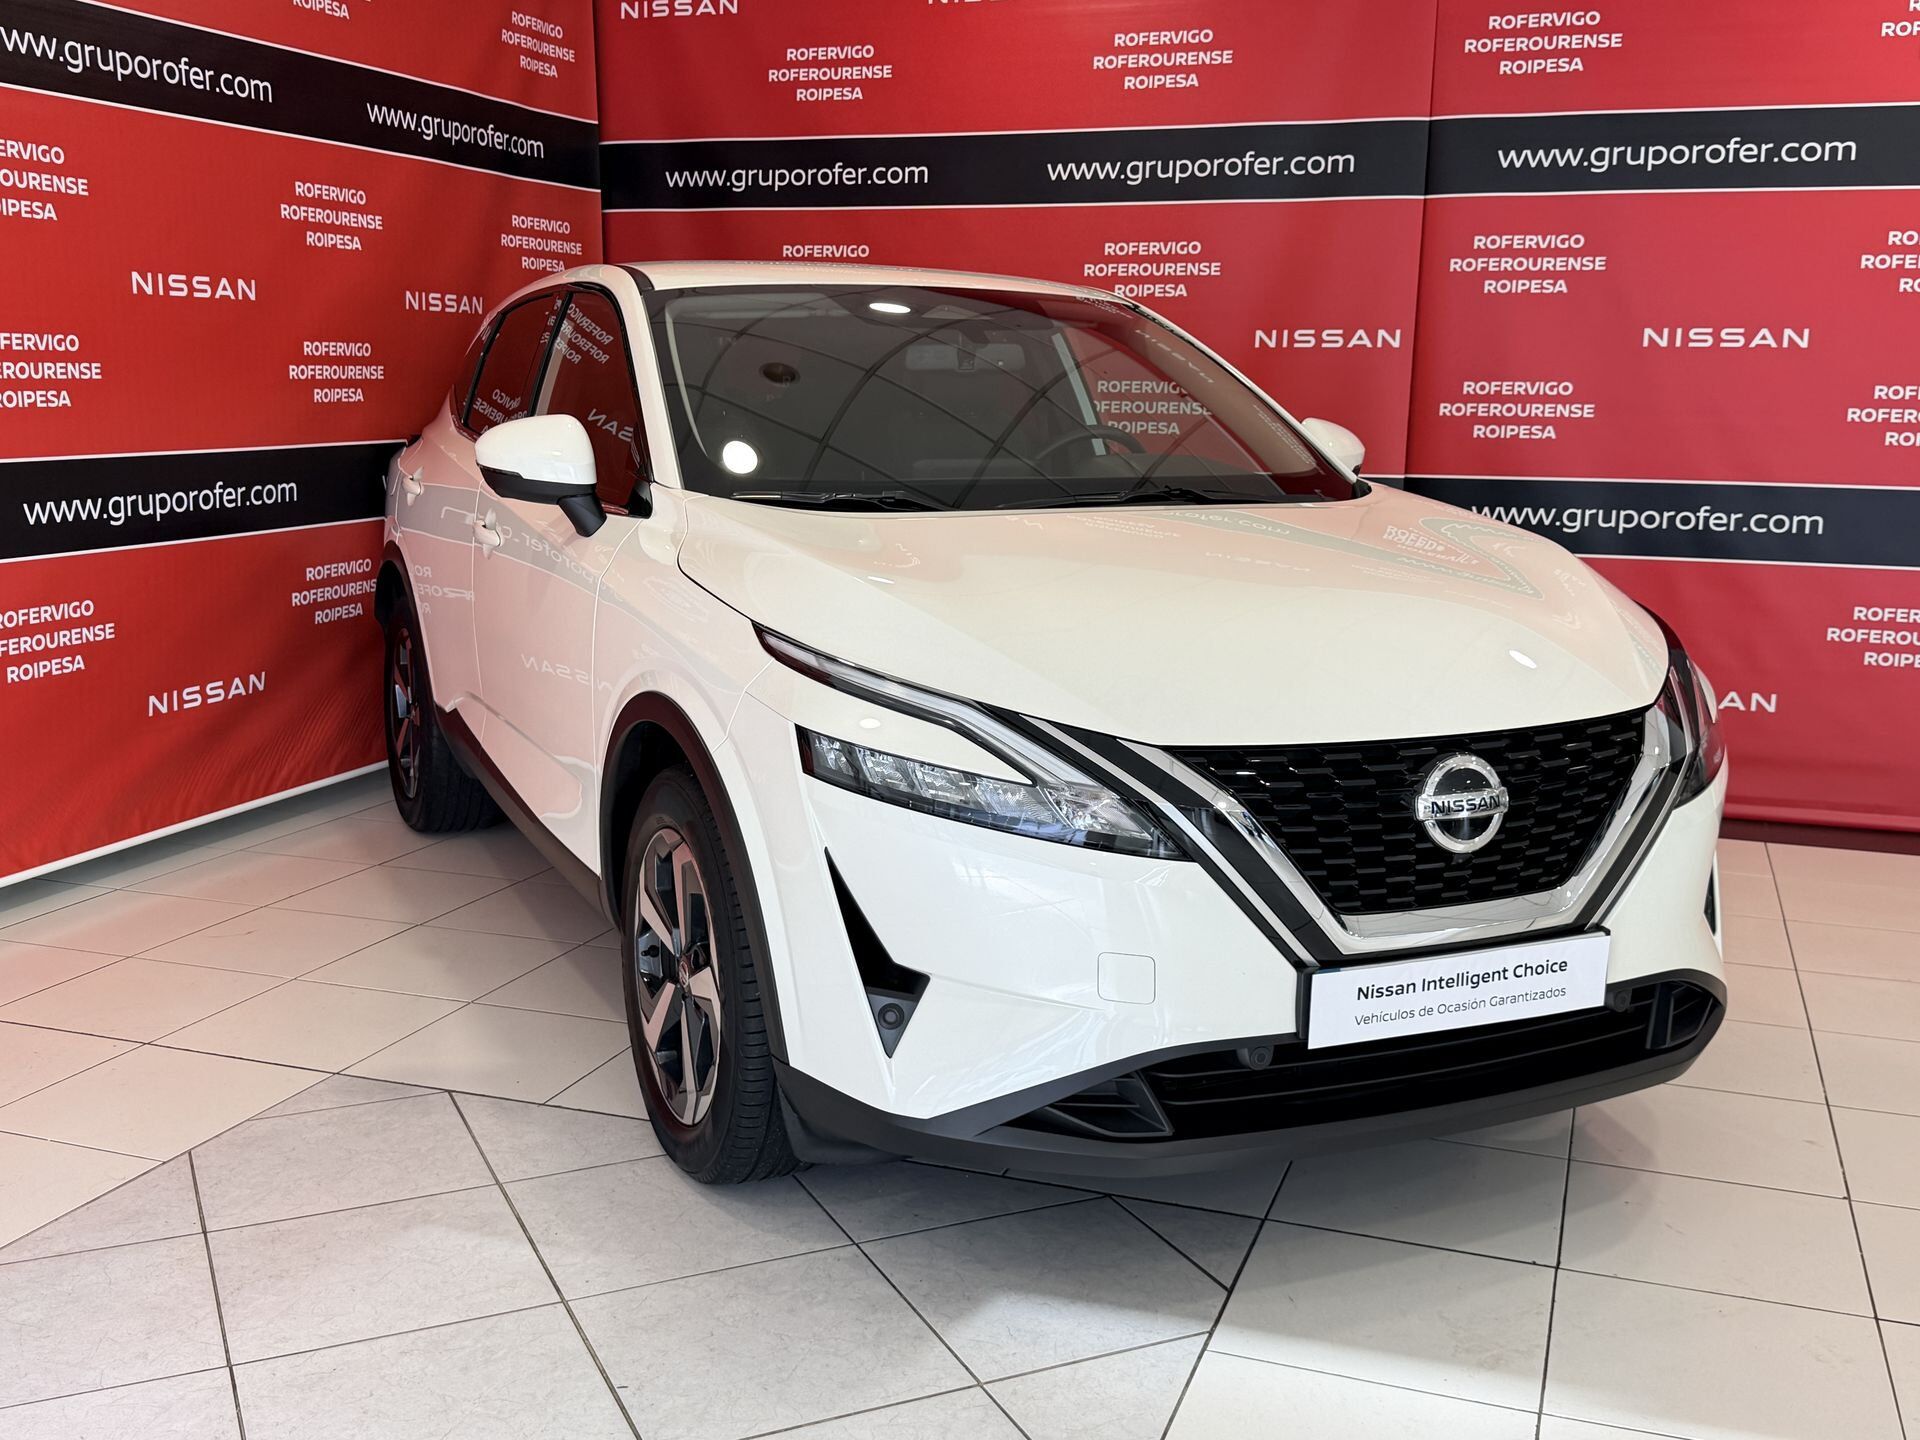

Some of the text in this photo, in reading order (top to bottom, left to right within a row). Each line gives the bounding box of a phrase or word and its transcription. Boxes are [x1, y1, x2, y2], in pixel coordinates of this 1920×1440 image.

[621, 0, 738, 19] NISSAN
[512, 12, 563, 39] ROFERVIGO
[1489, 10, 1601, 29] ROFERVIGO
[502, 30, 575, 63] ROFEROURENSE
[1114, 29, 1213, 47] ROFERVIGO
[1465, 33, 1623, 53] ROFEROURENSE
[786, 45, 874, 61] ROFERVIGO
[1093, 50, 1233, 70] ROFEROURENSE
[520, 55, 559, 78] ROIPESA
[768, 65, 892, 82] ROFEROURENSE
[1499, 57, 1583, 75] ROIPESA
[1124, 73, 1199, 90] ROIPESA
[796, 86, 863, 101] ROIPESA
[367, 102, 545, 159] www.gruporofer.com
[1497, 137, 1857, 172] www.gruporofer.com
[665, 162, 929, 192] www.gruporofer.com
[1047, 151, 1355, 185] www.gruporofer.com
[295, 181, 366, 206] ROFERVIGO
[0, 198, 57, 220] IPESA
[280, 203, 383, 230] ROFEROURENSE
[511, 214, 571, 235] ROFERVIGO
[306, 230, 362, 251] ROIPESA
[501, 233, 582, 255] ROFEROURENSE
[1473, 234, 1584, 250] ROFERVIGO
[1888, 230, 1920, 246] RO
[782, 244, 870, 258] ROFERVIGO
[1104, 240, 1201, 256] ROFERVIGO
[521, 256, 566, 273] ROIPESA
[1084, 262, 1221, 277] ROFEROURENSE
[1449, 256, 1607, 272] ROFEROURENSE
[1861, 254, 1920, 269] ROFE
[131, 271, 256, 301] NISSAN
[1114, 283, 1188, 298] ROIPESA
[1483, 279, 1567, 294] ROIPESA
[405, 290, 483, 315] NISSAN
[1254, 328, 1401, 348] NISSAN
[1642, 328, 1810, 349] NISSAN
[303, 341, 372, 357] ROFERVIGO
[0, 361, 102, 379] ROURENSE
[289, 364, 385, 380] ROFEROURENSE
[313, 388, 364, 403] ROIPESA
[1462, 381, 1574, 396] ROFERVIGO
[1873, 385, 1920, 400] ROF
[0, 390, 71, 408] OIPESA
[1439, 402, 1595, 418] ROFEROURENSE
[1846, 407, 1920, 423] ROFER
[1473, 424, 1556, 440] ROIPESA
[23, 480, 297, 526] www.gruporofer.com
[305, 558, 372, 581] ROFERVIGO
[314, 602, 364, 625] ROIPESA
[6, 654, 86, 684] ROIPESA
[148, 671, 266, 716] NISSAN
[1431, 795, 1500, 814] NISSAN
[1356, 959, 1568, 1001] Nissan Intelligent Choice
[1354, 986, 1567, 1026] Vehículos de Ocasión Garantizados
